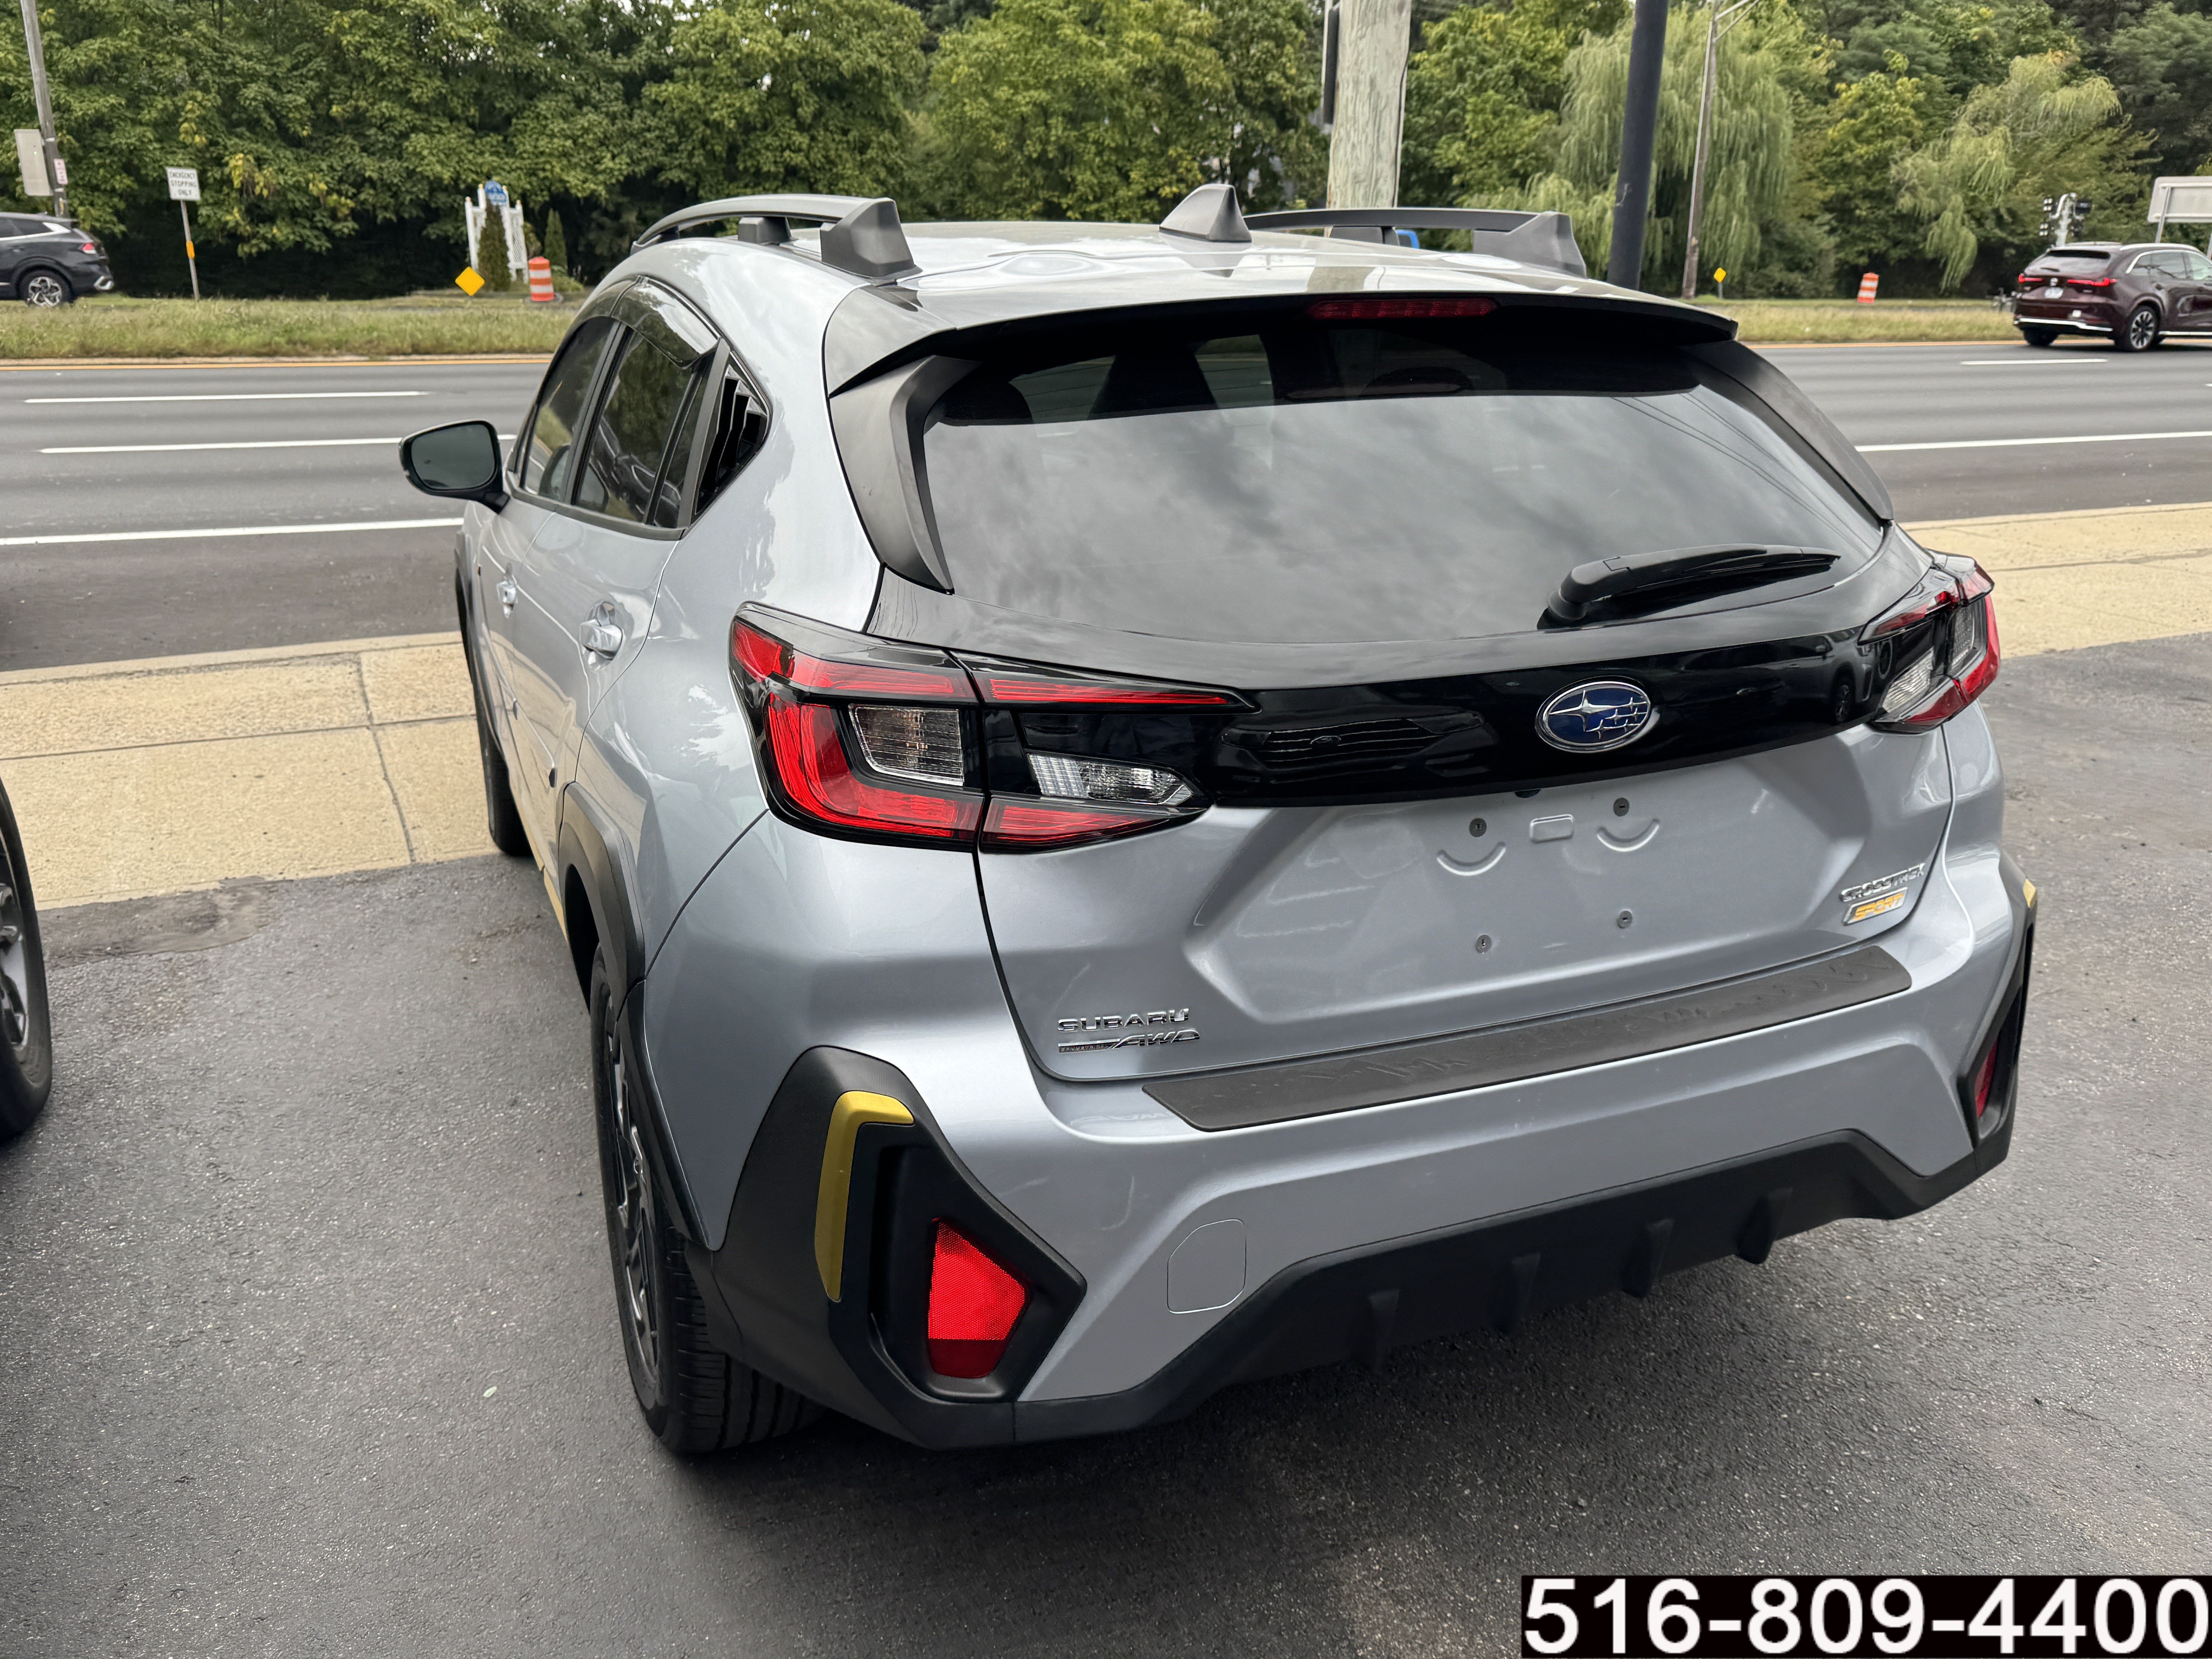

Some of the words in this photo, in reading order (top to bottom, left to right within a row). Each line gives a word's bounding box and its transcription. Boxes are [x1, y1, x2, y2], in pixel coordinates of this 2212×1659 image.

[1853, 892, 1904, 921] SPORT
[1057, 1008, 1189, 1033] SUBARU
[1111, 1028, 1200, 1050] AWD
